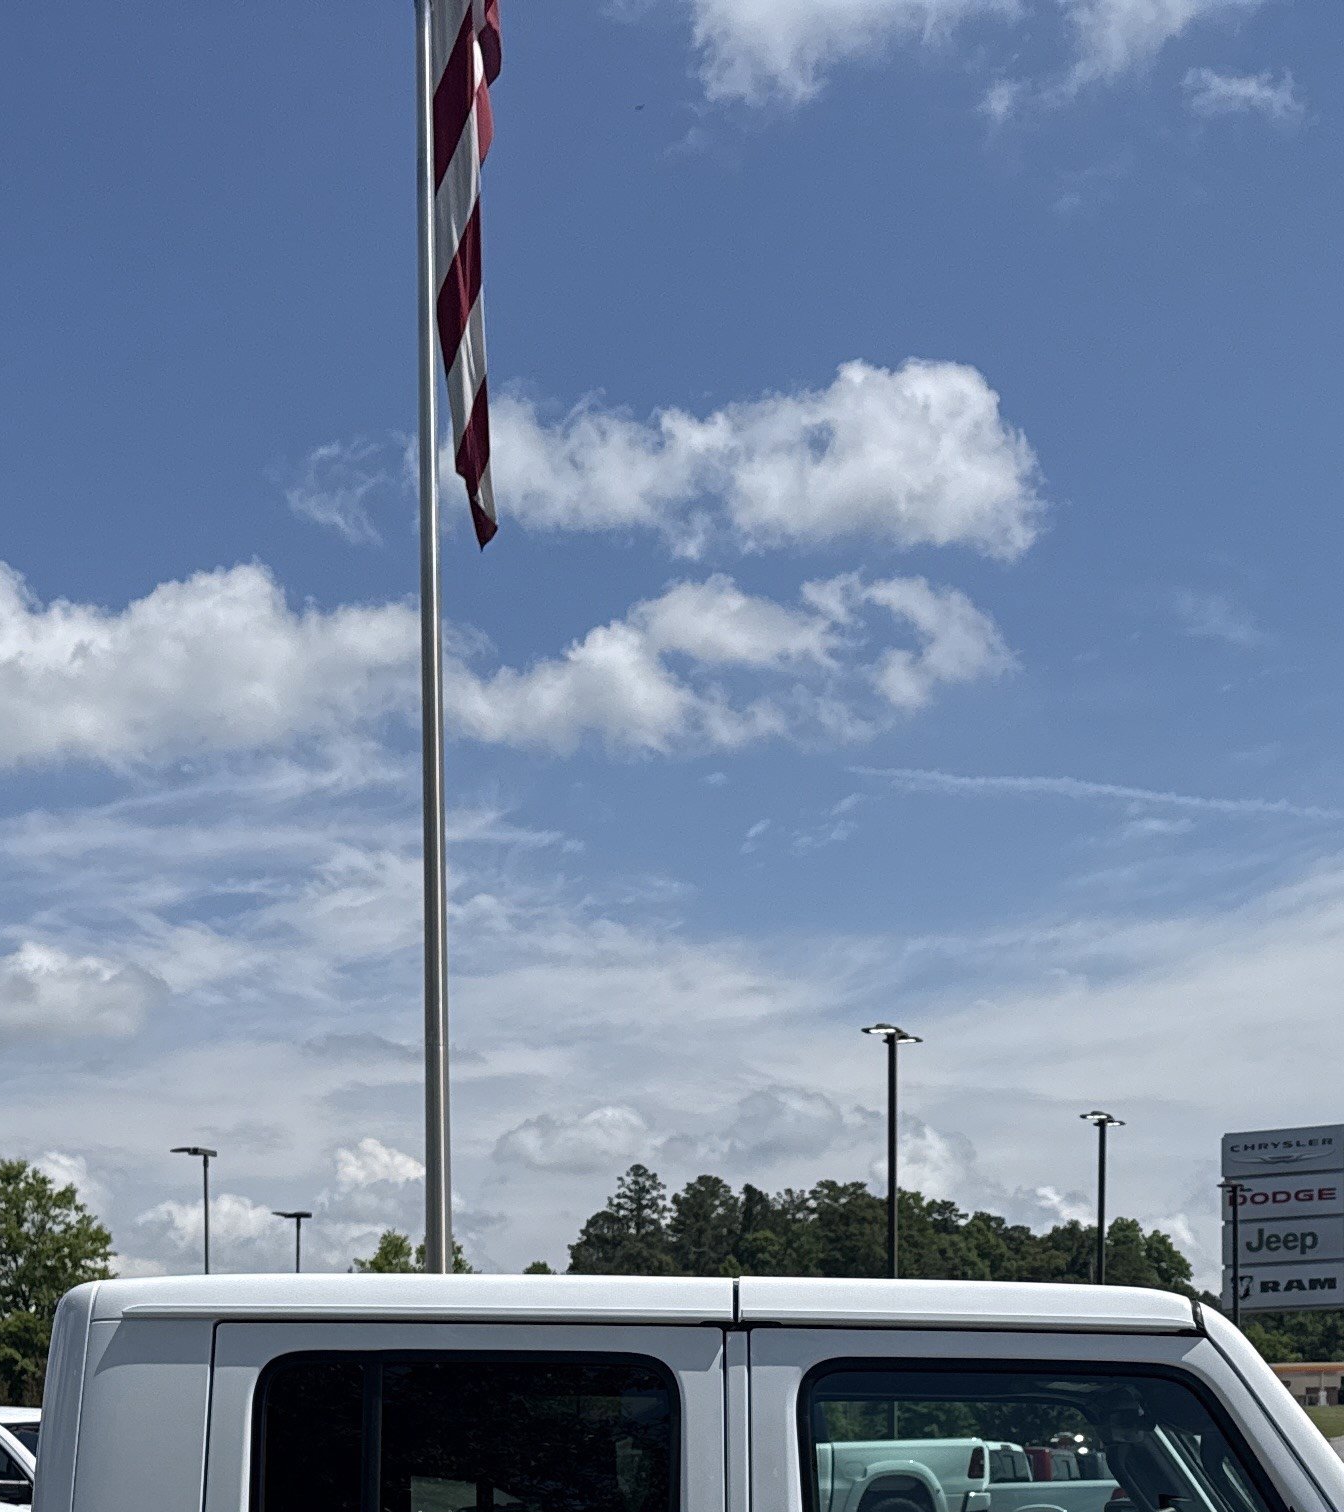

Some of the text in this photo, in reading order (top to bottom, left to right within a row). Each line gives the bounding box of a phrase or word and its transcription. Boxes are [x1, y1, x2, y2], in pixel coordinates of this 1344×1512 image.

[1230, 1137, 1333, 1152] CHRYSLER
[1228, 1187, 1337, 1206] DODGE
[1246, 1228, 1319, 1255] Jeep
[1260, 1277, 1337, 1293] RAM
